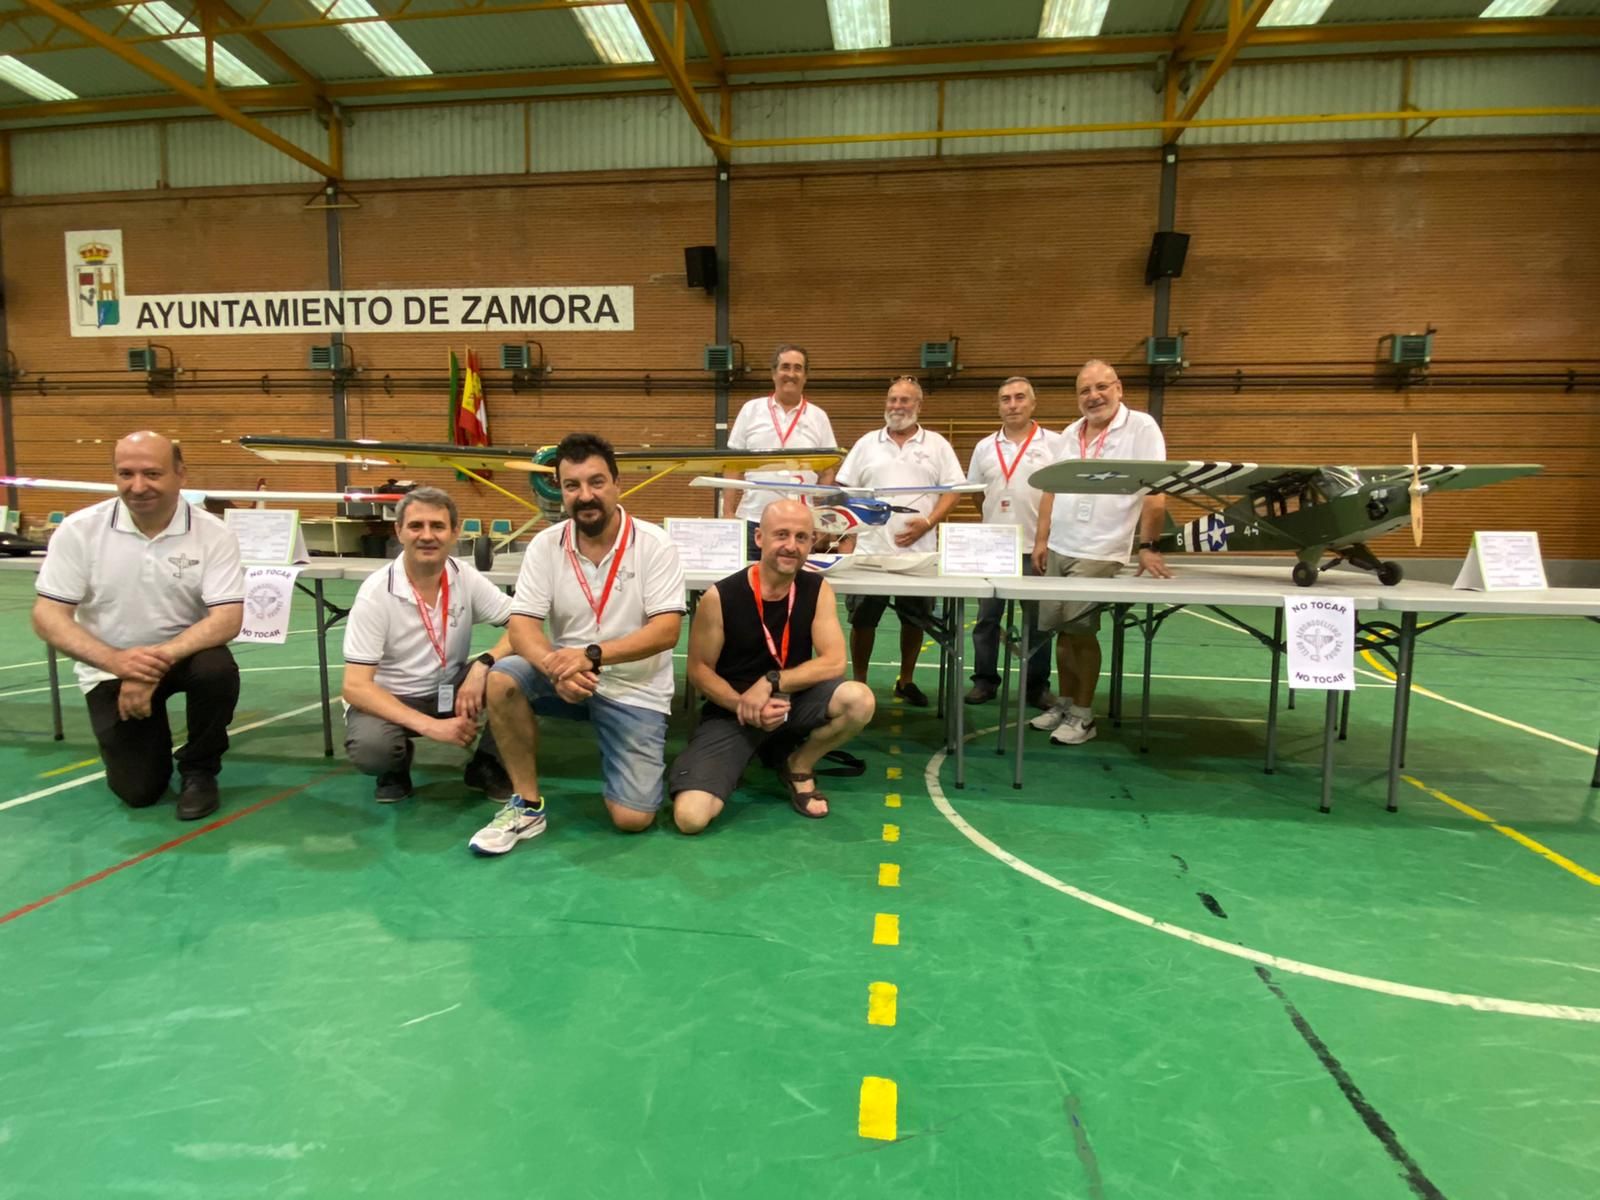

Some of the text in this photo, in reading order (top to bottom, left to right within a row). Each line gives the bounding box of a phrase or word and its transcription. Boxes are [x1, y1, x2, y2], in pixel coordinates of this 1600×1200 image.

[136, 294, 620, 329] AYUNTAMIENTO DE ZAMORA
[1176, 532, 1184, 546] 6
[249, 569, 292, 580] NO TOCAR
[1291, 602, 1347, 614] NO TOCAR
[241, 627, 281, 638] NO TOCAR
[1295, 672, 1346, 684] NO TOCAR
